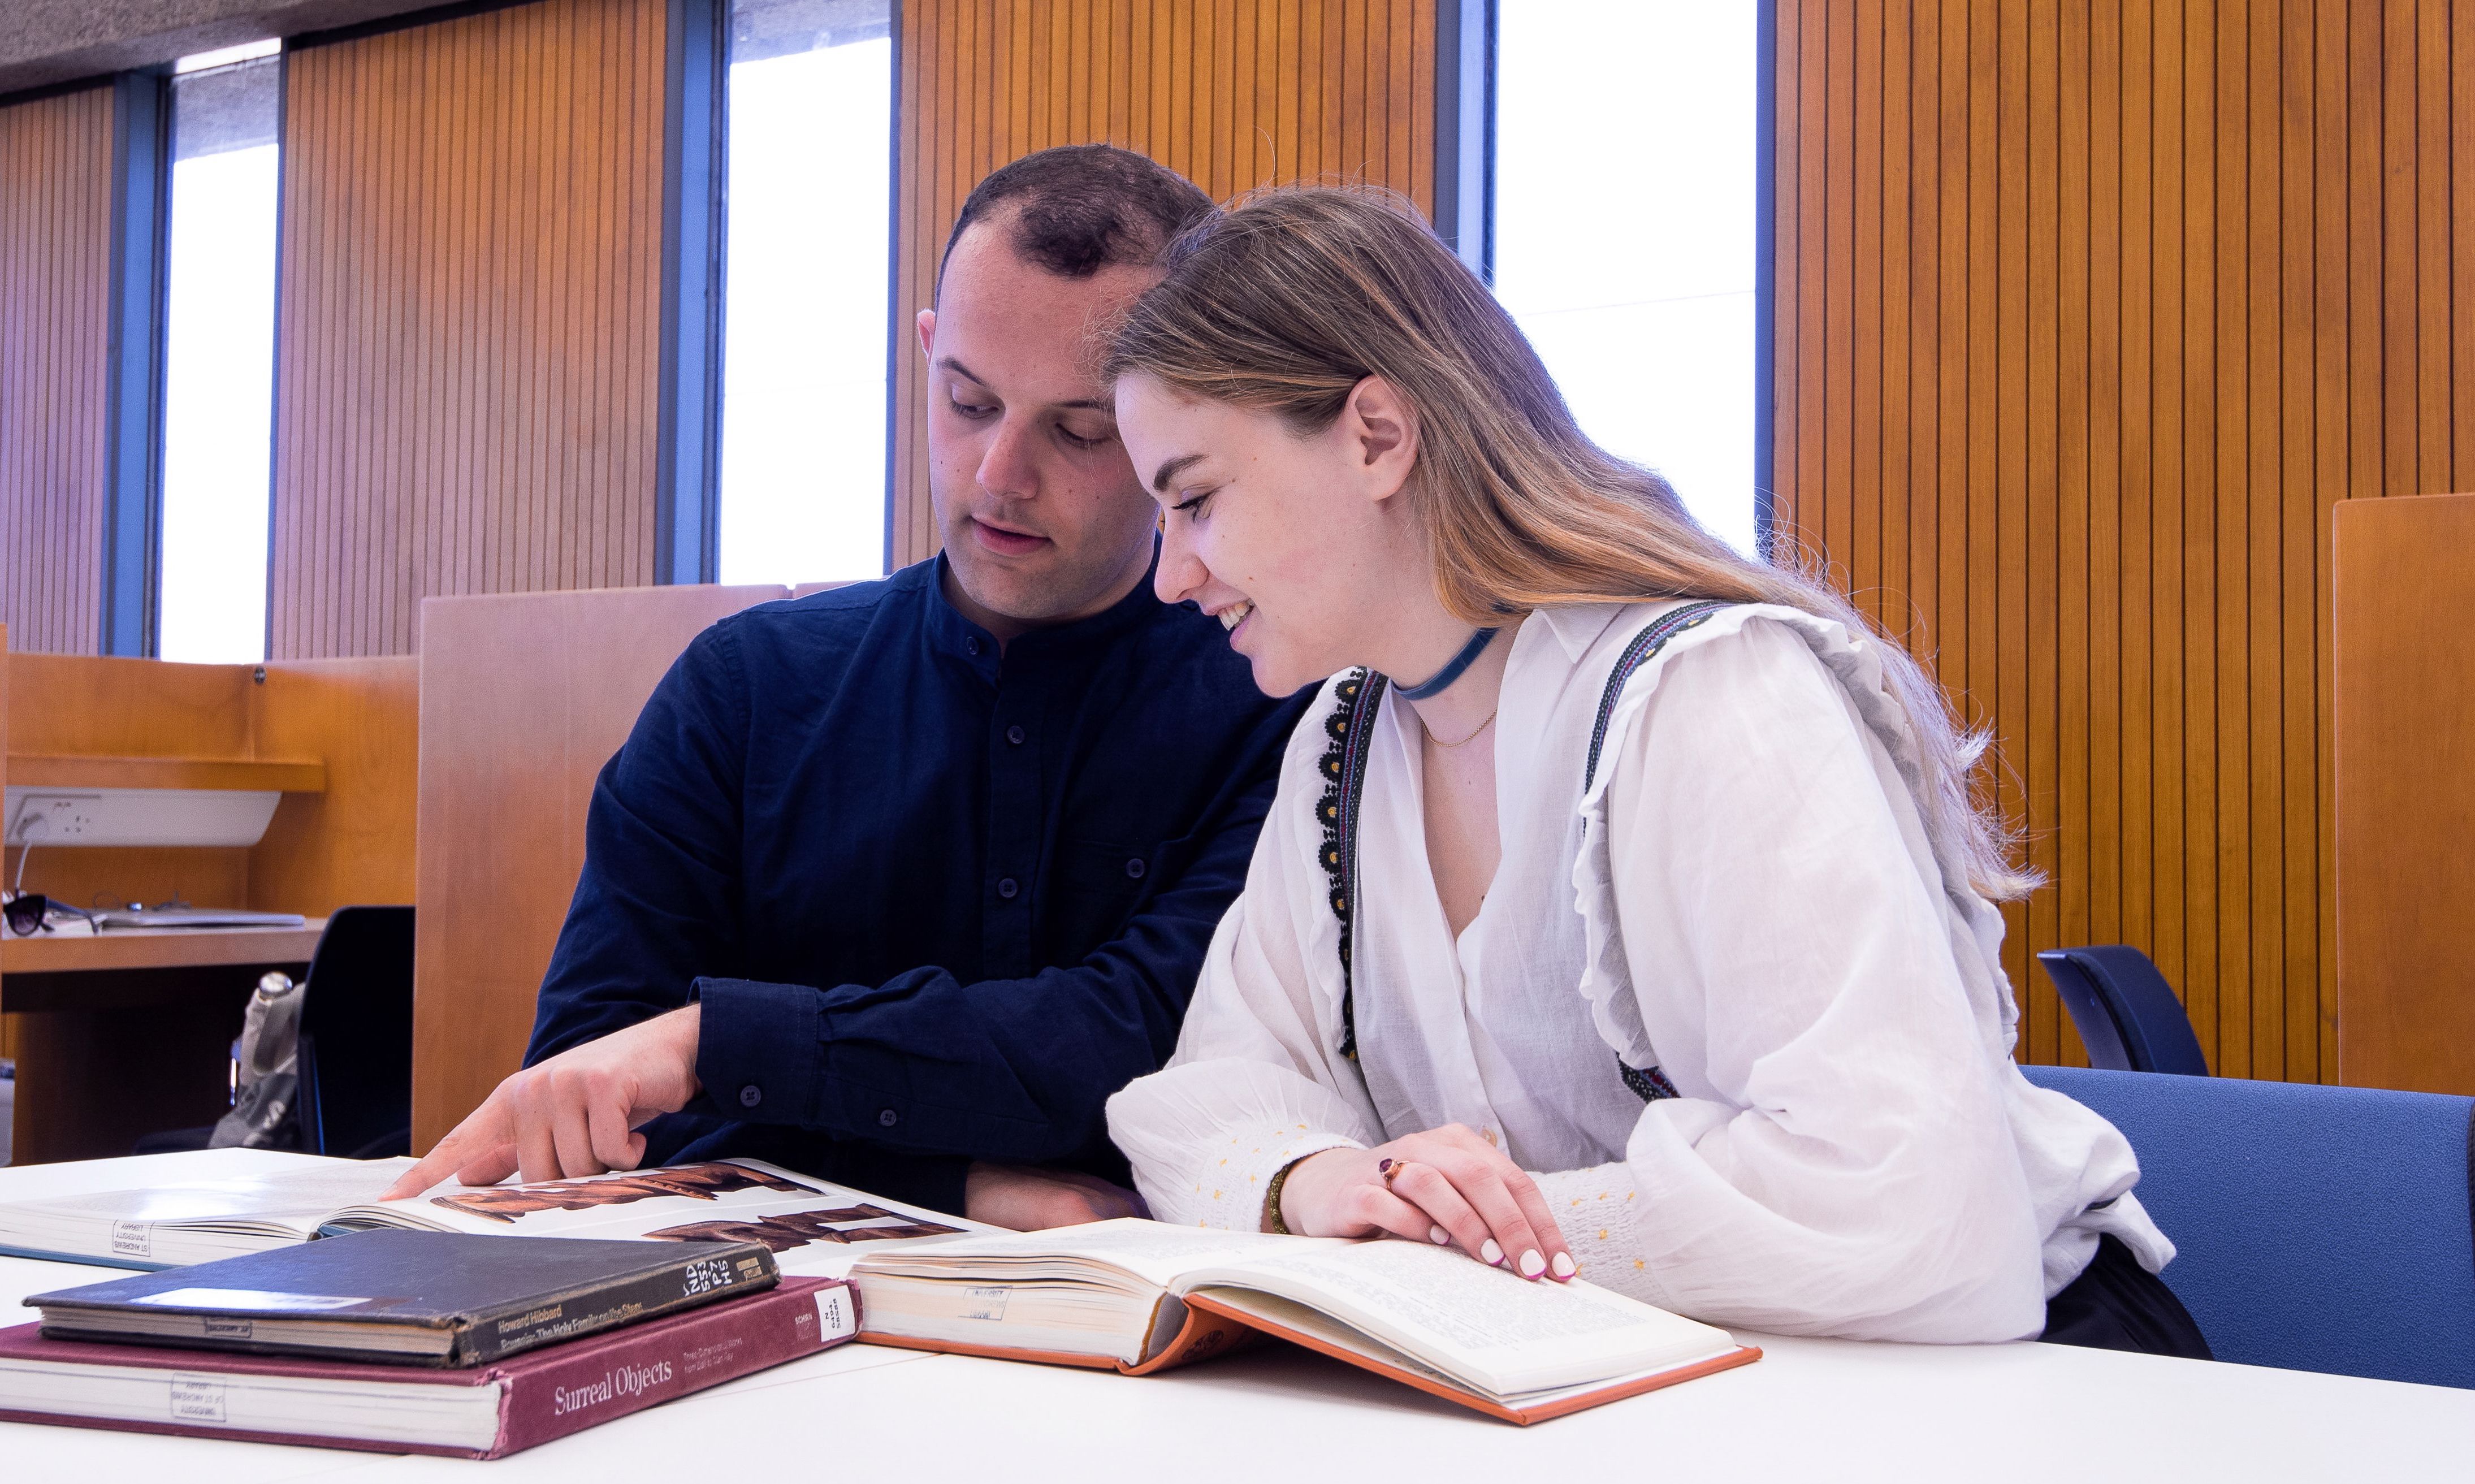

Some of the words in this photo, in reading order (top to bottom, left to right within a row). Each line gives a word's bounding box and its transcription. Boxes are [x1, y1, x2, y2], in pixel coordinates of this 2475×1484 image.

[120, 1222, 144, 1232] LIBRARY
[114, 1240, 140, 1251] ANDREWS
[116, 1231, 146, 1242] UNIVERSITY
[498, 1313, 530, 1334] Howard
[529, 1304, 562, 1326] Hibbard
[536, 1328, 553, 1339] The
[553, 1321, 572, 1335] Holy
[572, 1313, 598, 1332] Family
[555, 1371, 612, 1416] Surreal
[616, 1360, 672, 1396] Objects
